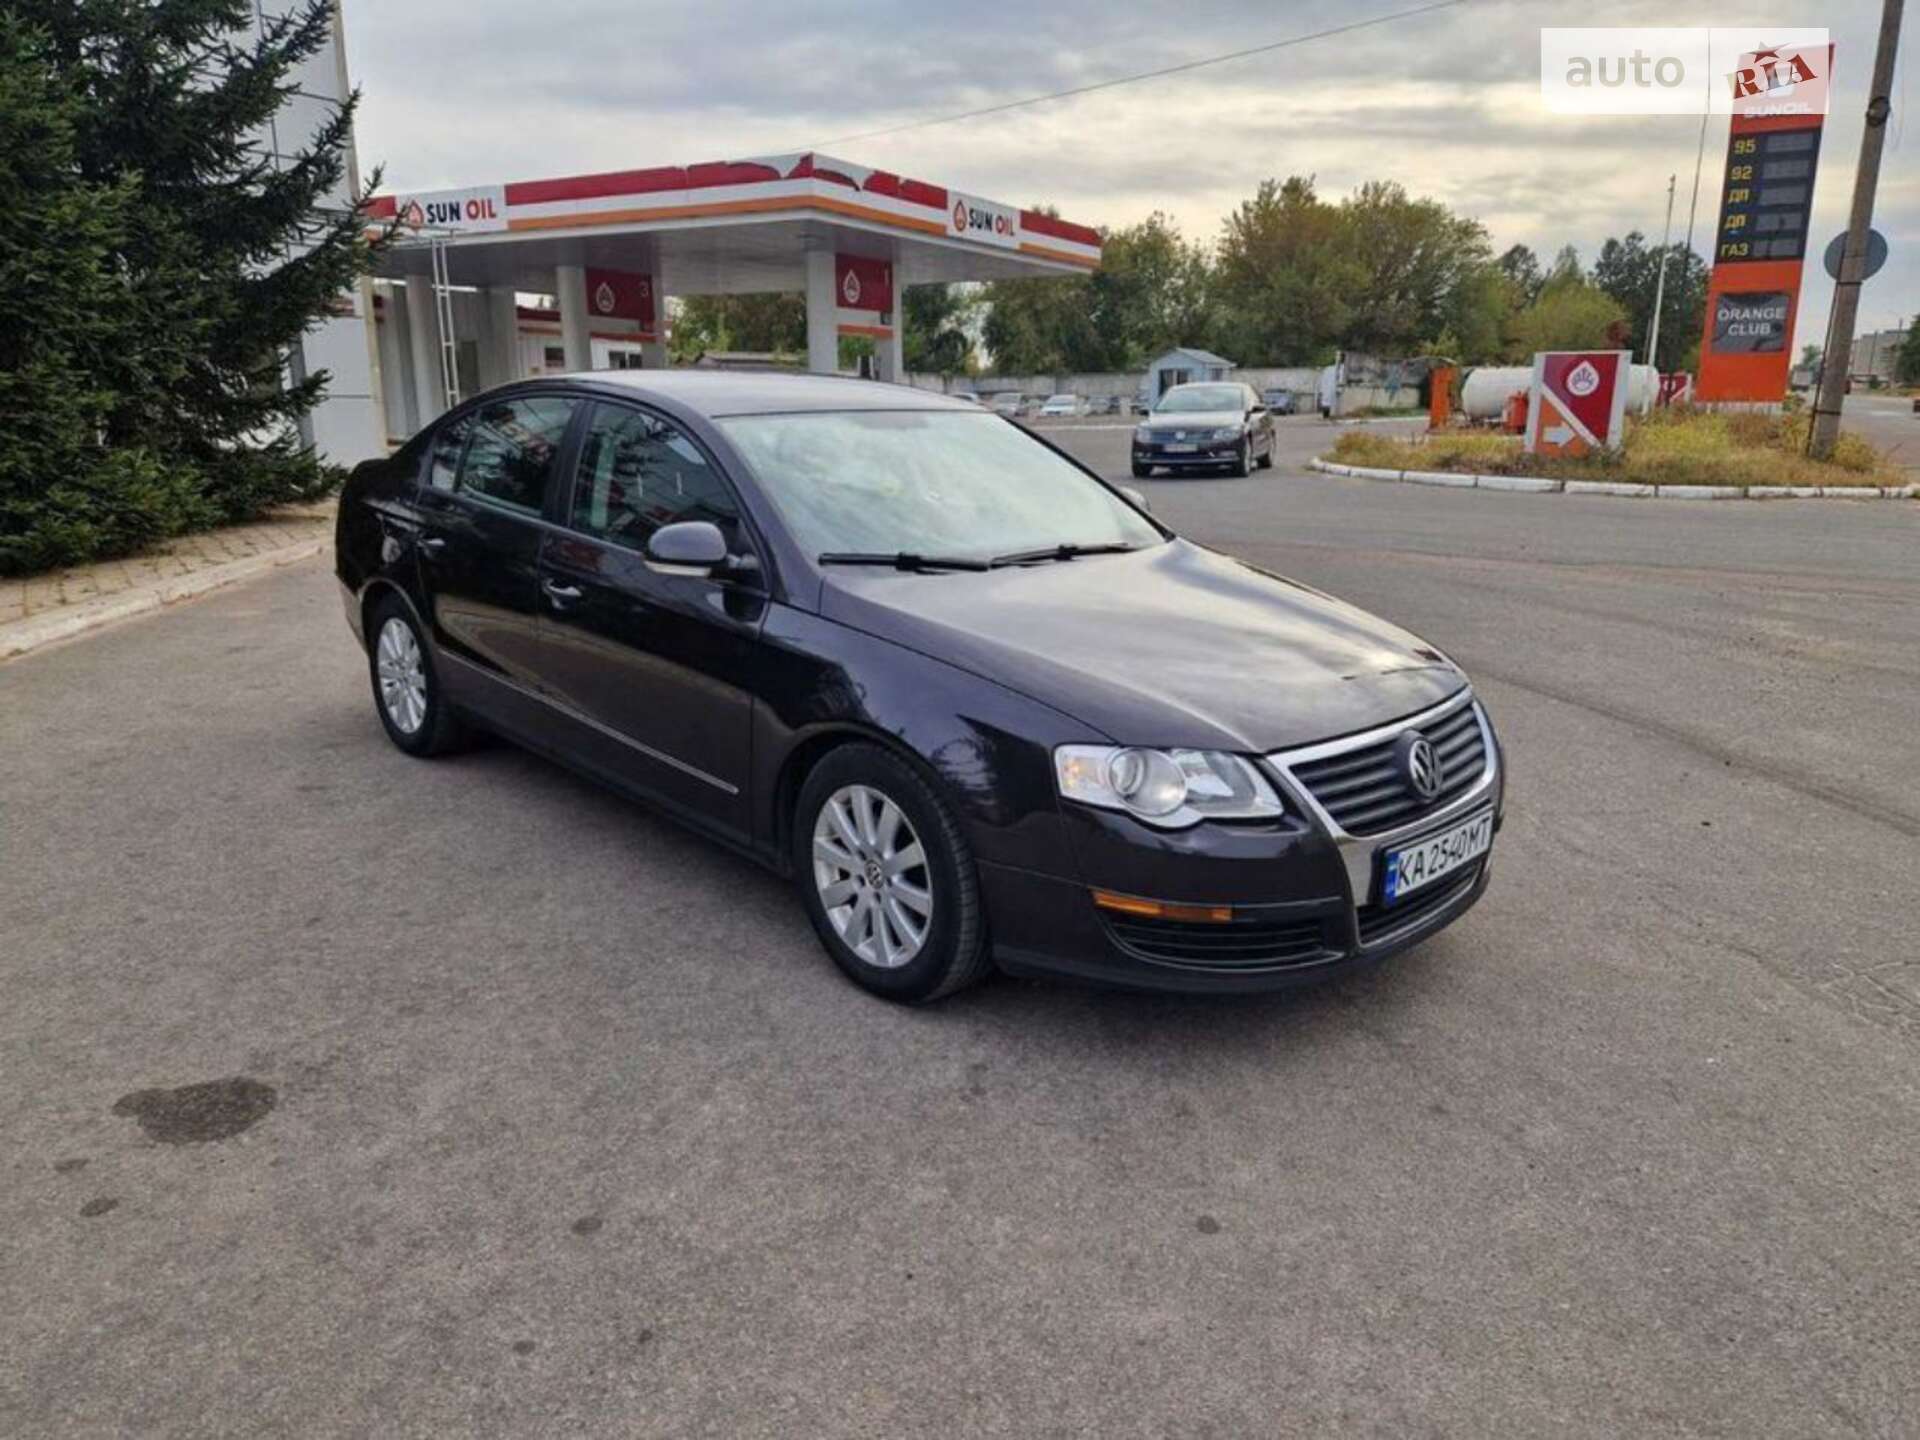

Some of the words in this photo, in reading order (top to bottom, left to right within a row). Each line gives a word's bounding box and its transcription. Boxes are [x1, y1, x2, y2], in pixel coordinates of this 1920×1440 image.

[1733, 139, 1756, 154] 95
[1730, 166, 1753, 180] 92
[426, 202, 461, 223] SUN
[466, 198, 497, 221] OIL
[968, 208, 993, 232] SUN
[995, 214, 1016, 237] OIL
[1717, 307, 1787, 321] ORANGE
[1728, 322, 1772, 337] CLUB
